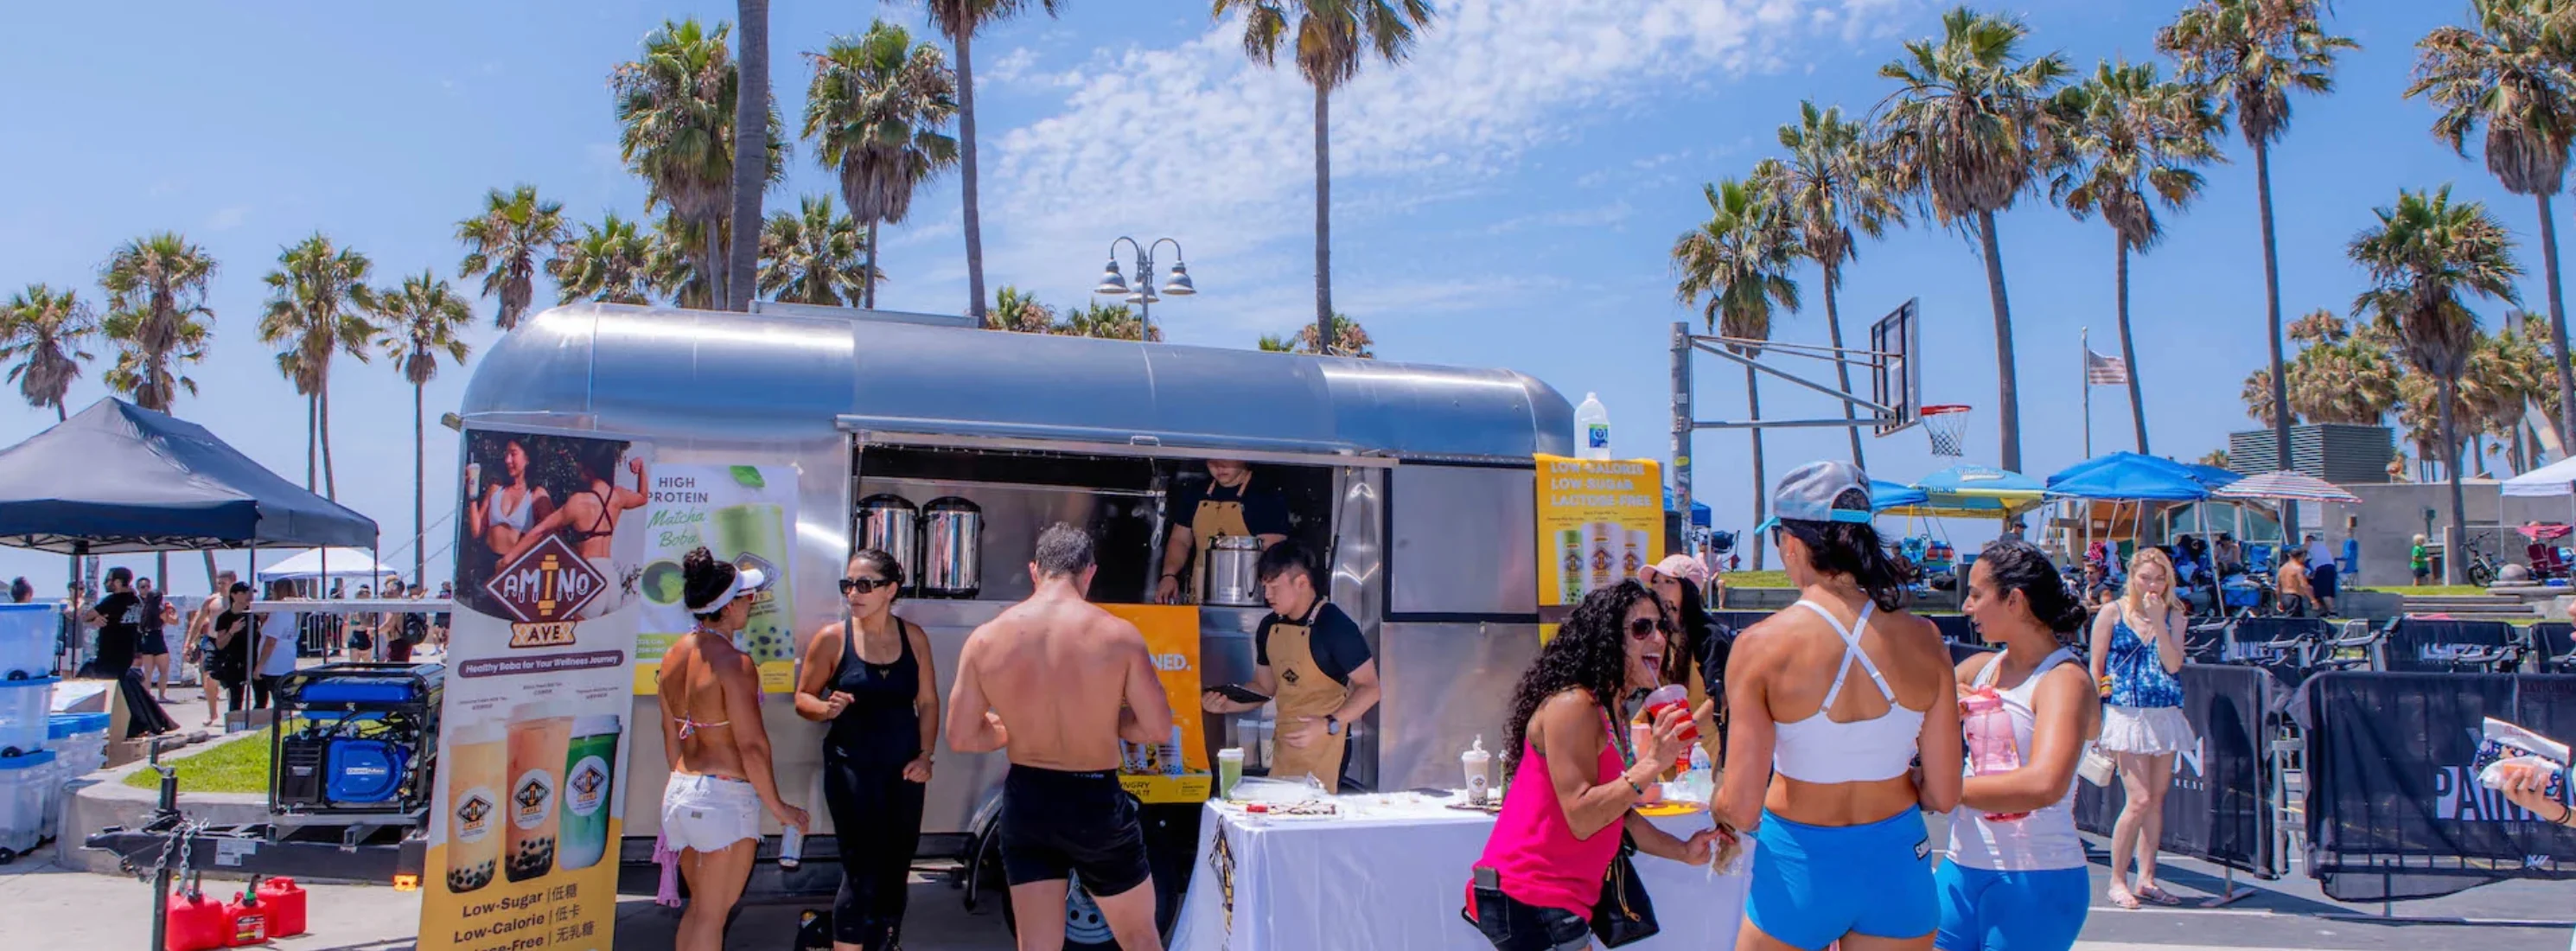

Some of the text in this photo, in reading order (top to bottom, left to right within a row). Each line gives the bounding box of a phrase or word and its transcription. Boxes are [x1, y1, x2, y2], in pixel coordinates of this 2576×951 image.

[659, 477, 695, 488] HIGH
[648, 492, 708, 503] PROTEIN
[647, 507, 705, 529] Matcha
[659, 530, 698, 547] Boba
[503, 554, 590, 616] AMINO
[466, 654, 619, 674] Healthy Boba for Your Wellness Journey
[1150, 653, 1191, 672] NED.
[462, 891, 544, 918] Low-Sugar
[552, 883, 578, 902] 低糖
[454, 914, 545, 944] Low-Calorie
[555, 903, 582, 922] 低卡
[556, 920, 596, 943] 无乳糖
